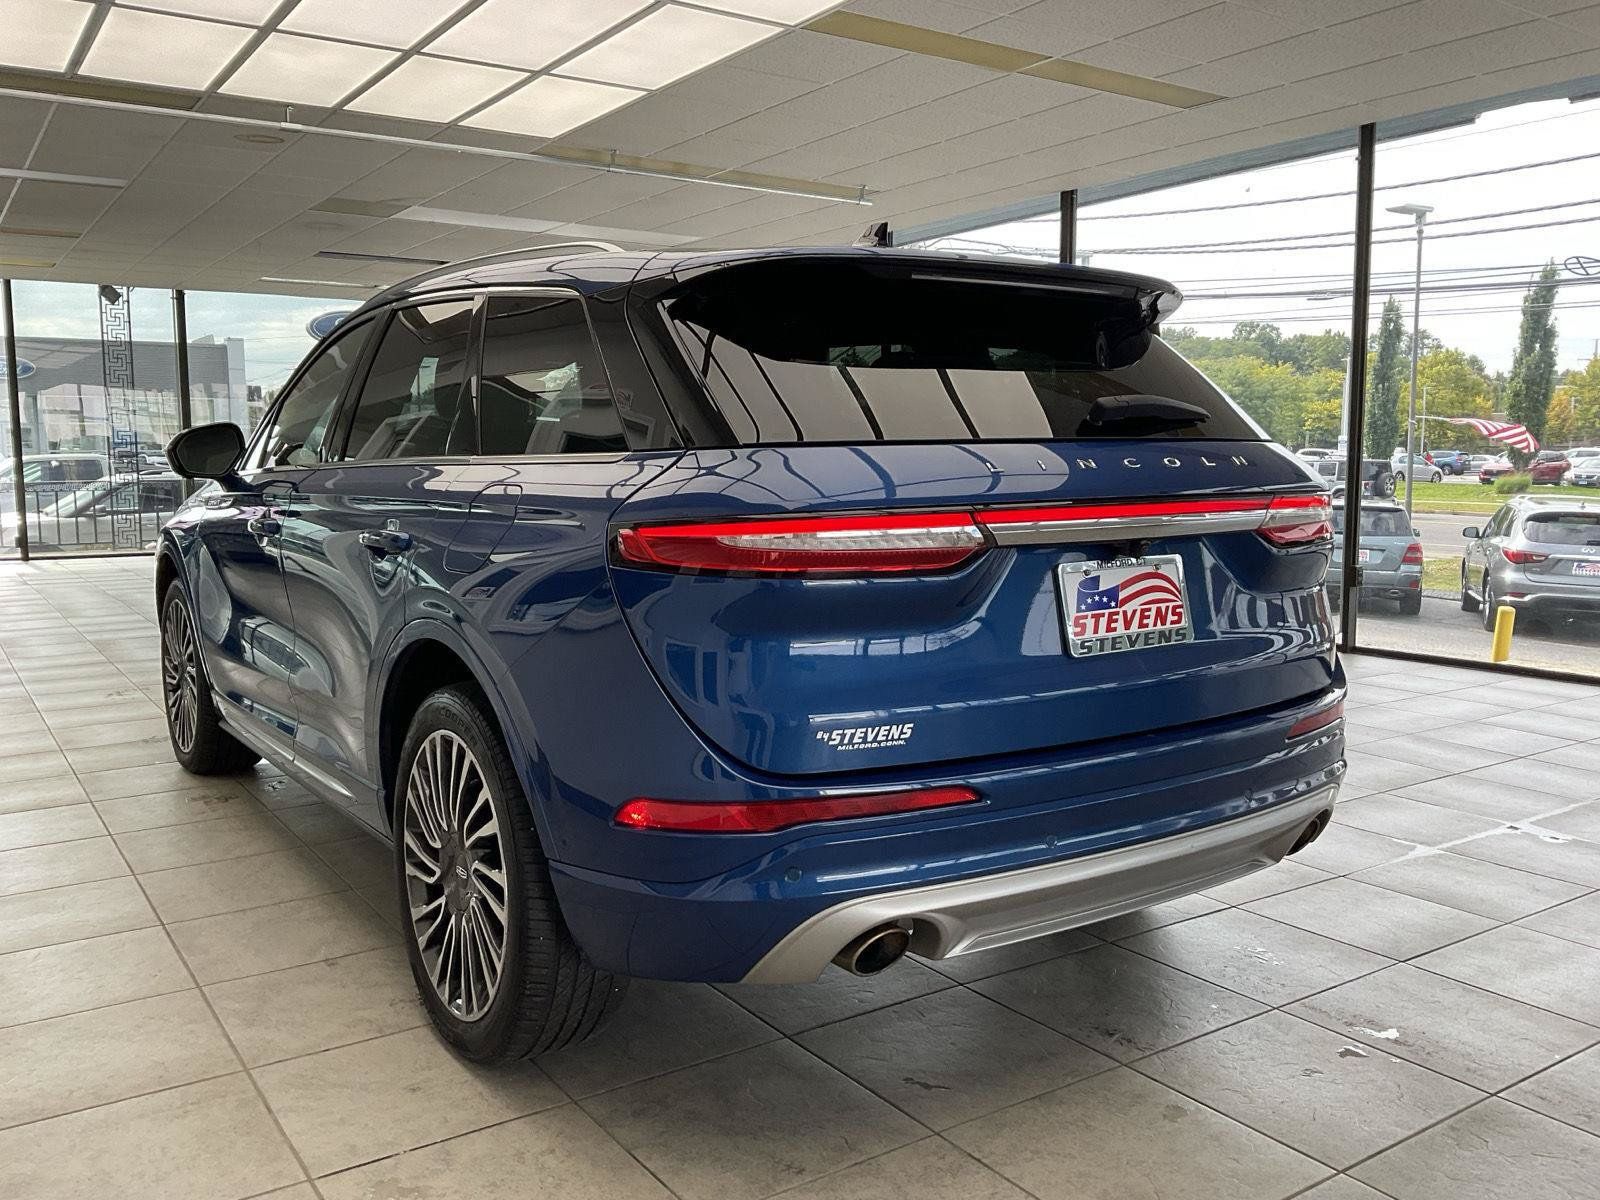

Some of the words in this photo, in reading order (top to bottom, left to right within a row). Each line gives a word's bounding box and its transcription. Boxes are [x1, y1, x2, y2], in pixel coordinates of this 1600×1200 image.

[985, 455, 1249, 473] LINCOLN
[1073, 604, 1184, 637] STEVENS
[1079, 627, 1187, 656] STEVENS
[828, 723, 914, 745] STEVENS
